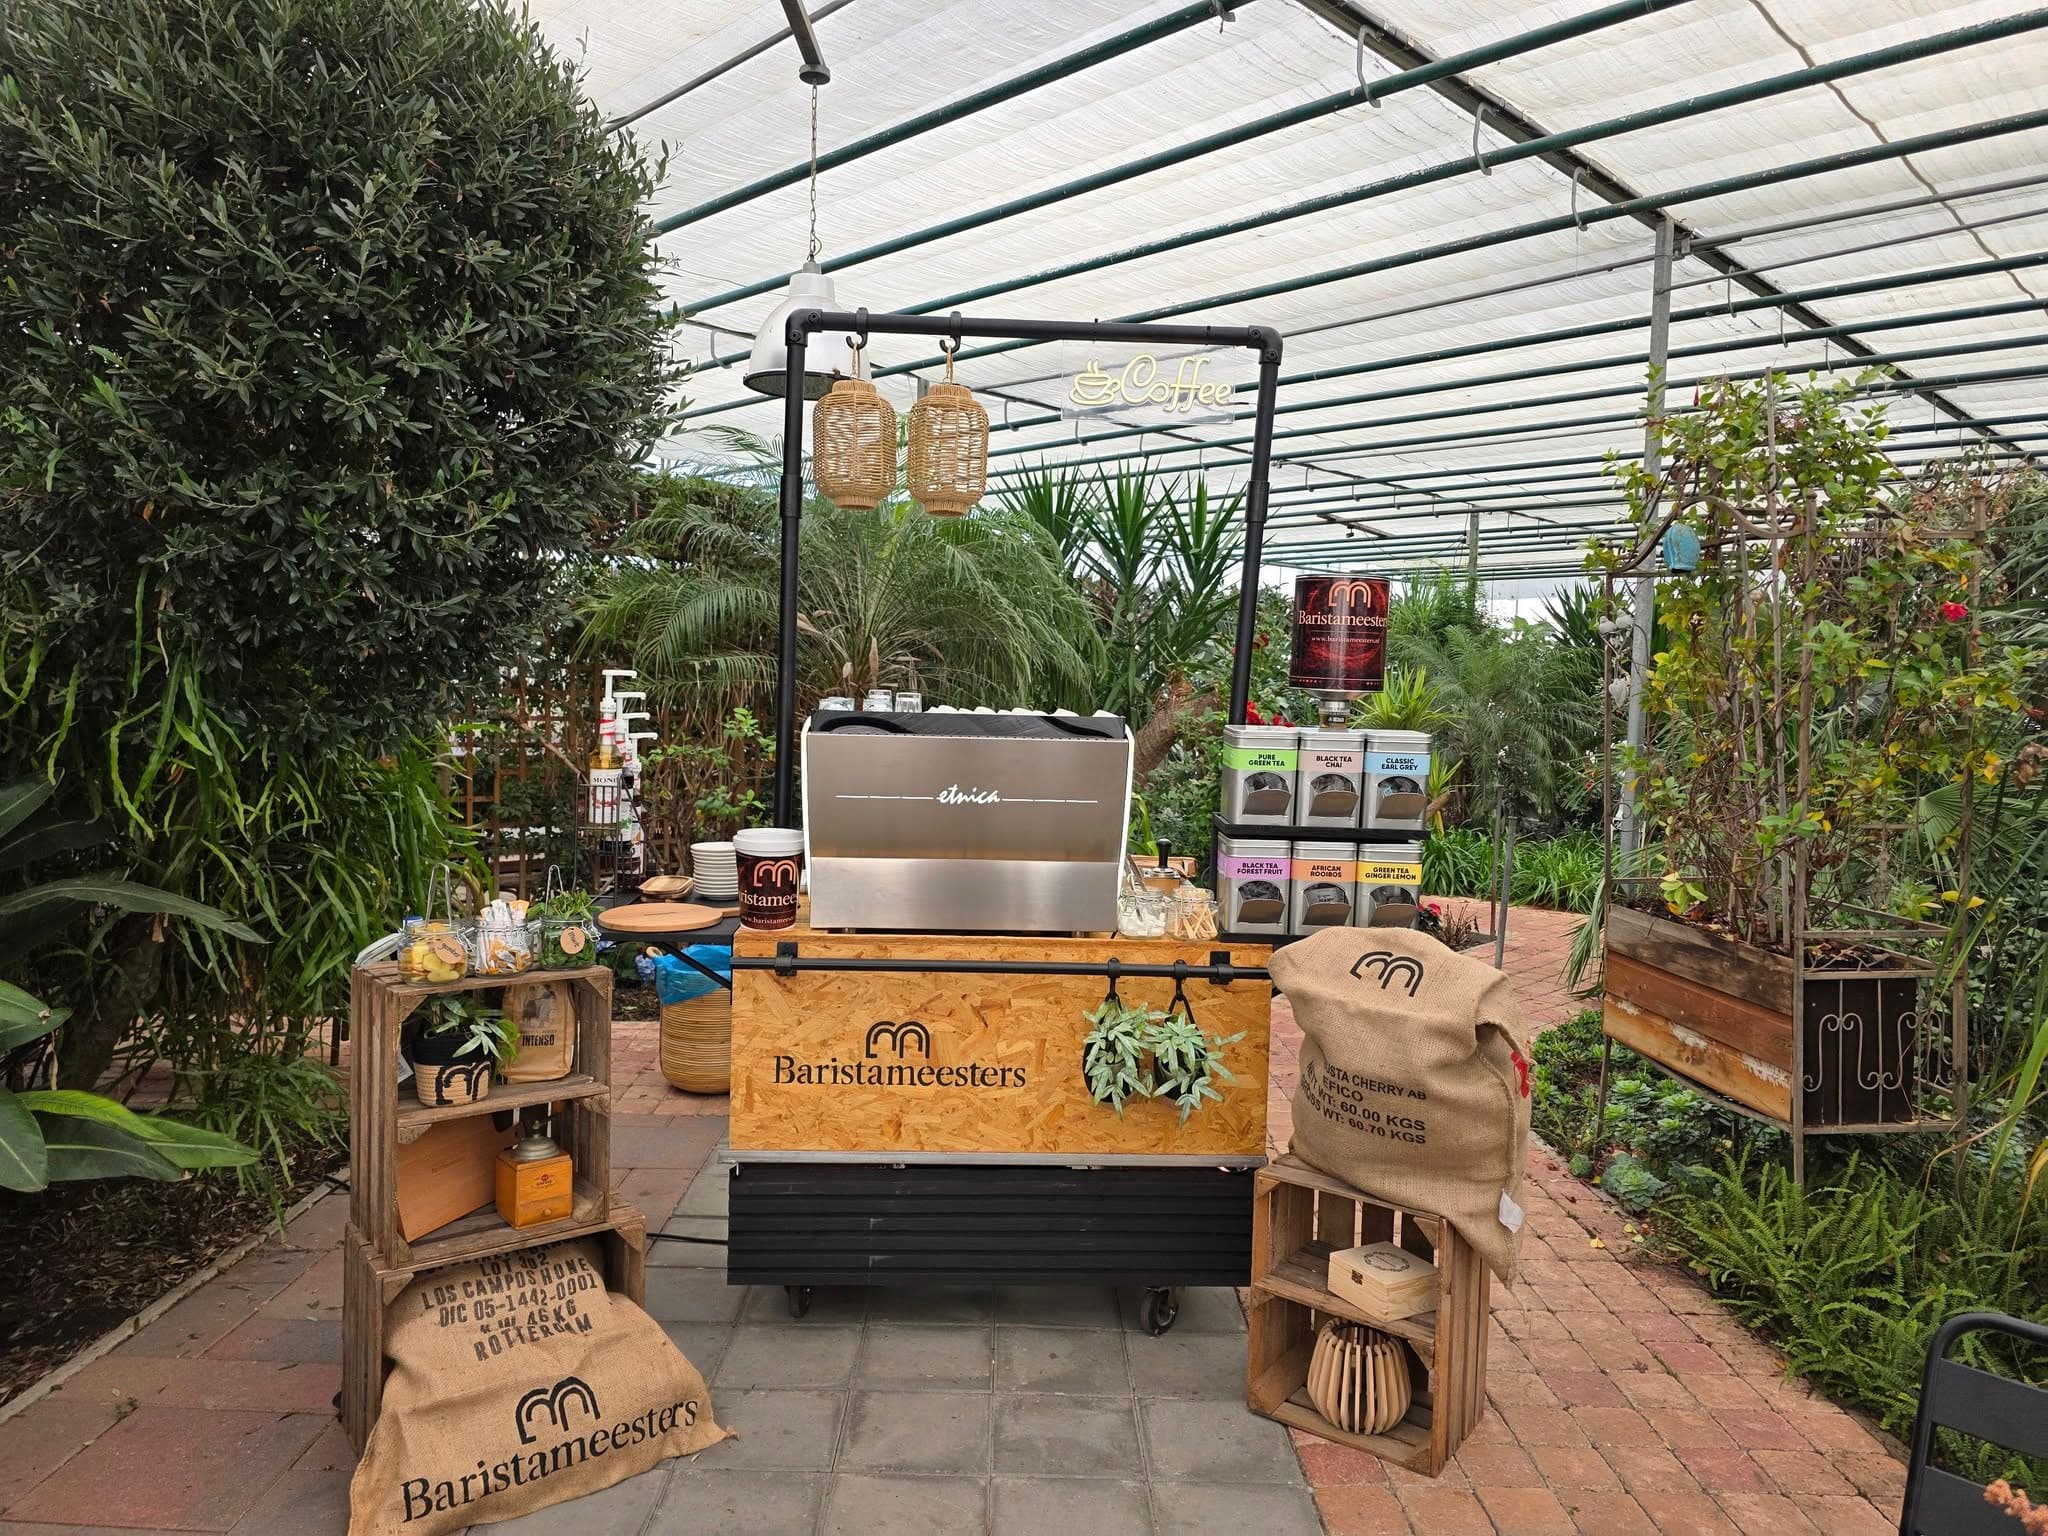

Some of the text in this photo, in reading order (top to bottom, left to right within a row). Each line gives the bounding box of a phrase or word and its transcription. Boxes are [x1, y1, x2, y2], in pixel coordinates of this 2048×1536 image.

[1120, 353, 1233, 413] Coffee
[1385, 757, 1414, 765] CLASSIC
[937, 784, 1000, 804] etnica
[1365, 872, 1392, 880] GINGER
[522, 1034, 555, 1047] INTENSO
[773, 1055, 1027, 1088] Baristameesters
[1322, 1075, 1363, 1102] EFICO
[1351, 1074, 1404, 1097] CHERRY
[1407, 1089, 1427, 1101] AB
[1323, 1105, 1345, 1124] WT:
[1348, 1117, 1386, 1137] 60.70
[1390, 1130, 1427, 1145] KGS
[1340, 1101, 1381, 1123] 60.00
[1386, 1114, 1427, 1132] KGS
[479, 1258, 514, 1277] LOT
[518, 1252, 550, 1270] 302
[421, 1283, 458, 1310] LOS
[462, 1268, 537, 1299] CAMPOS
[473, 1274, 598, 1321] 05-1442-0001
[473, 1312, 593, 1362] ROTTERDAM
[401, 1400, 699, 1524] Baristameesters
